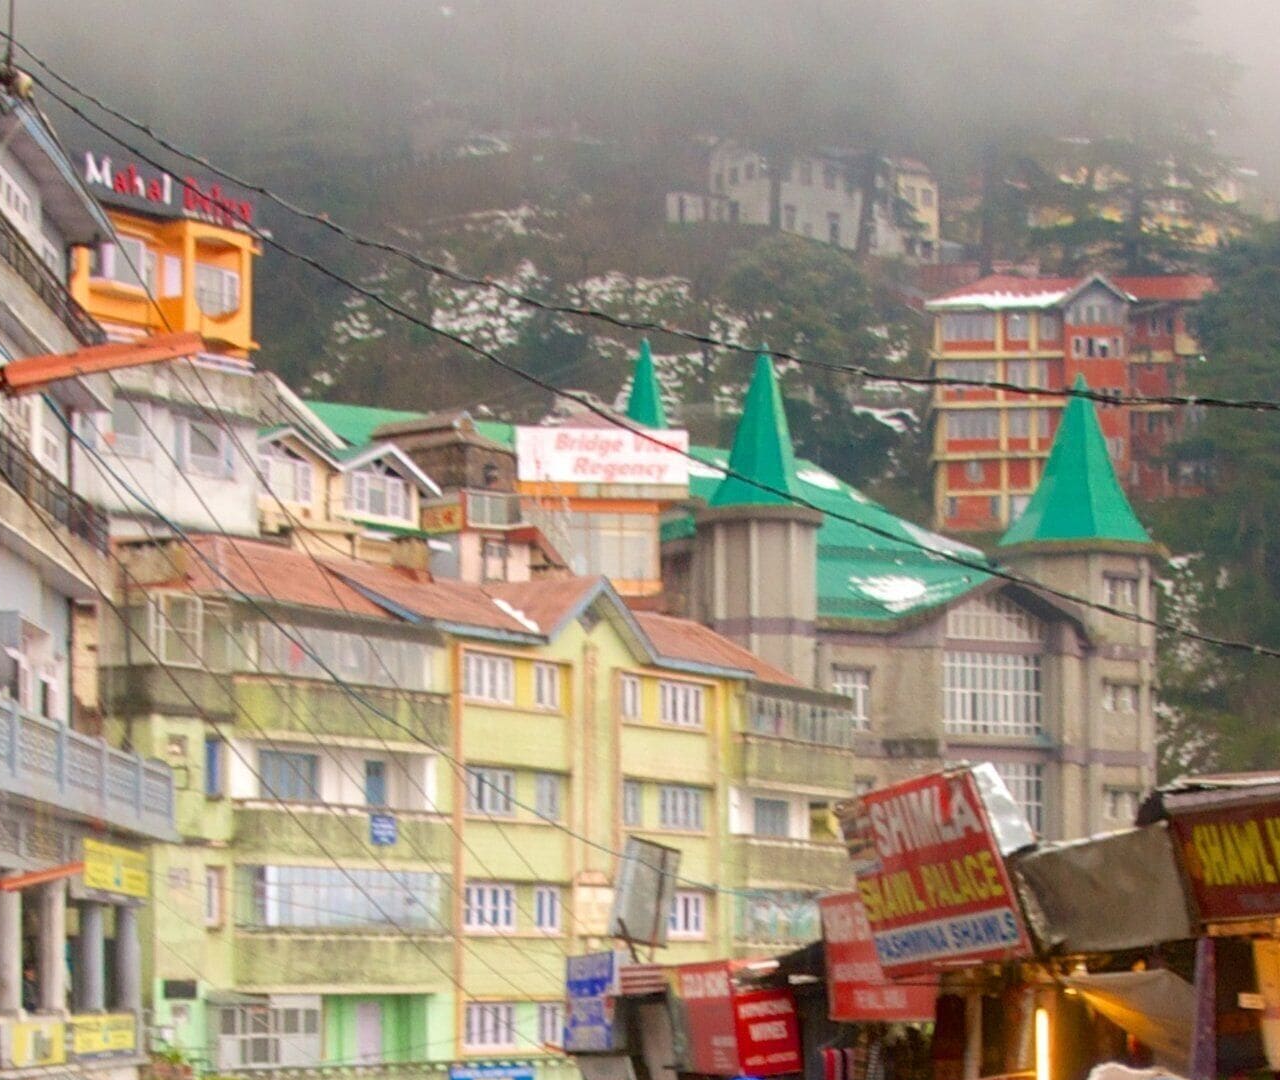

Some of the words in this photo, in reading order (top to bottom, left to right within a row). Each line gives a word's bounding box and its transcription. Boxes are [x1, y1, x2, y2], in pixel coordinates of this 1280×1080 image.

[84, 151, 172, 205] Mahal
[554, 432, 623, 456] Bridge
[633, 435, 683, 453] View
[573, 456, 669, 482] Regency
[869, 780, 983, 858] SHIMLA
[1191, 819, 1278, 886] SHAWL
[856, 868, 925, 923] SHAWL
[920, 850, 1005, 909] PALACE
[950, 911, 1019, 949] SHAWLS
